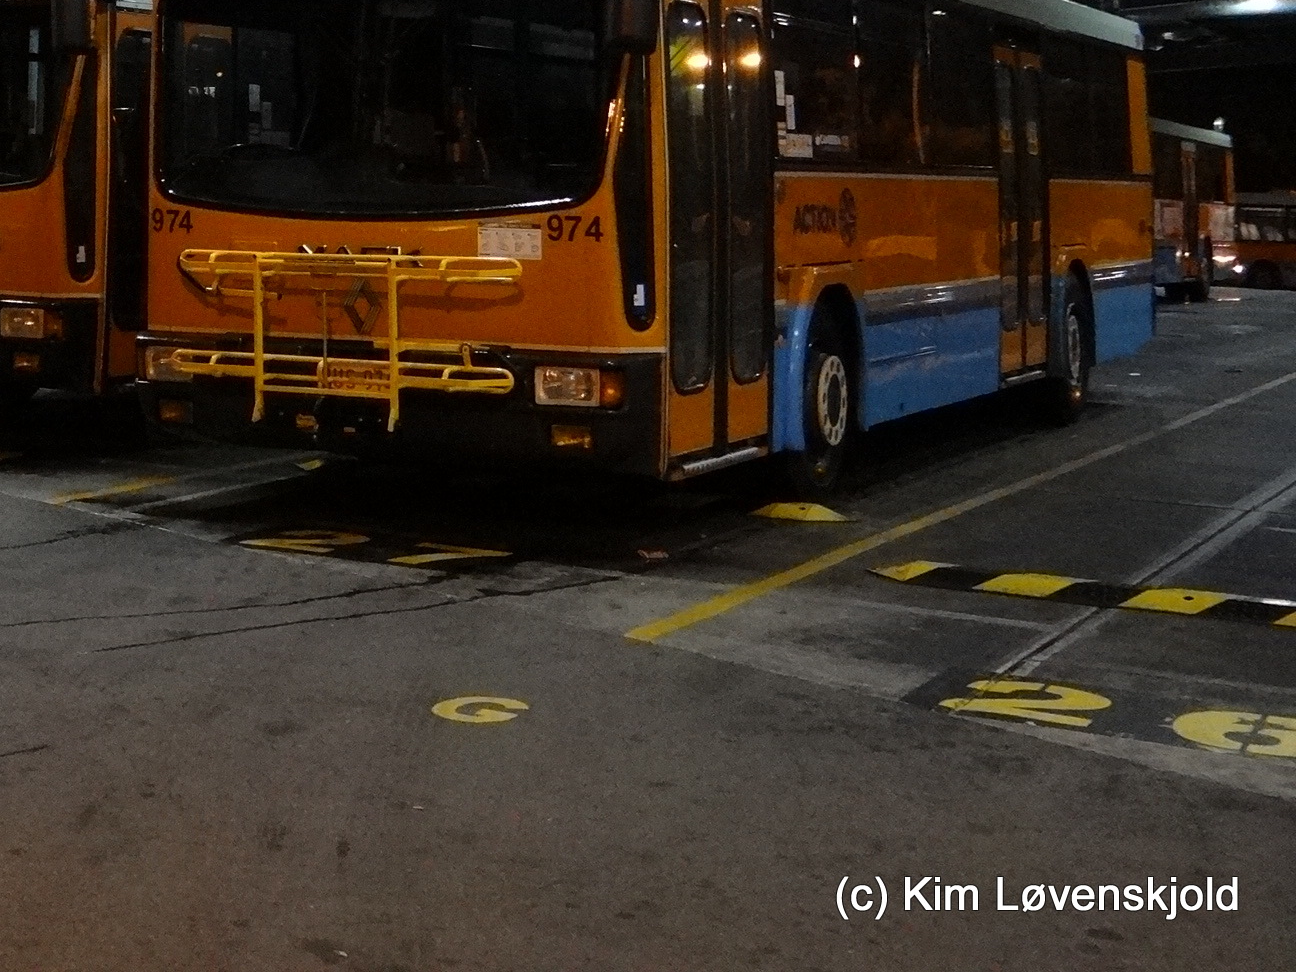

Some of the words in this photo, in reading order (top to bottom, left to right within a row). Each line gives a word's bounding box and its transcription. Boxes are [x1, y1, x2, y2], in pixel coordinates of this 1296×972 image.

[152, 209, 194, 235] 974
[546, 214, 604, 243] 974
[792, 204, 837, 234] ACTION
